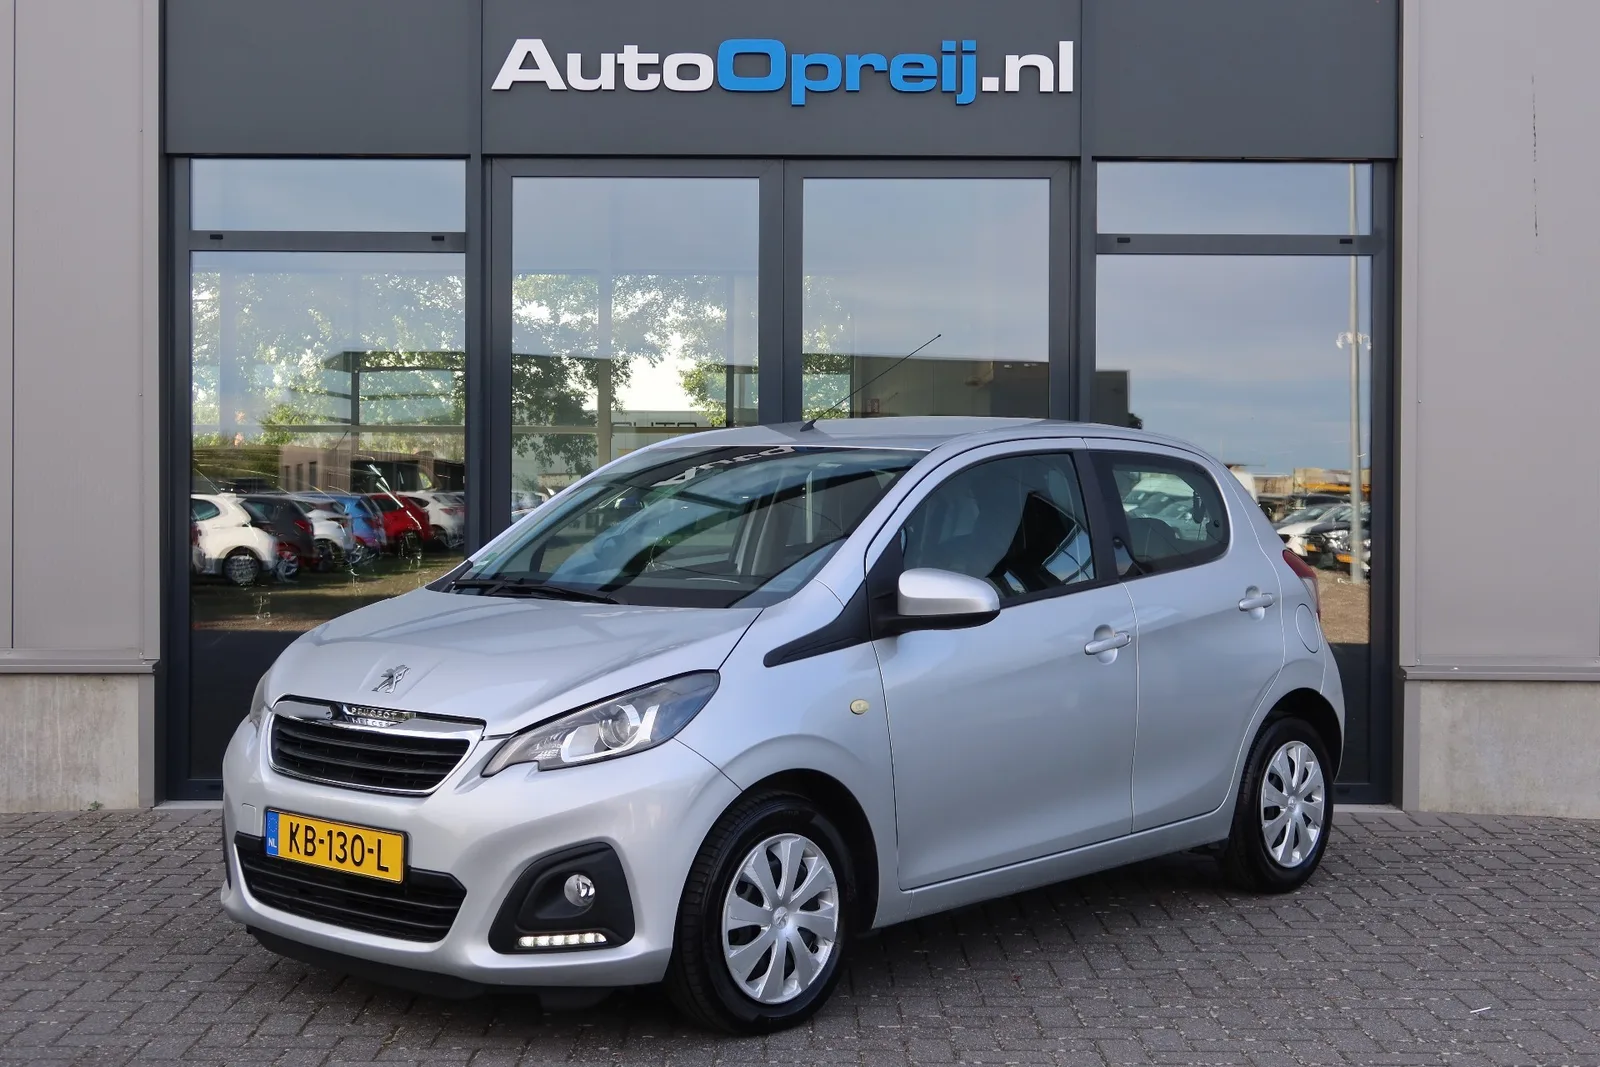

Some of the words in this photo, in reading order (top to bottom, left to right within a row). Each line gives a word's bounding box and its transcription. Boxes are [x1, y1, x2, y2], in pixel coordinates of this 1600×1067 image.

[491, 38, 1074, 105] AutoOpreij.nl
[351, 707, 397, 720] PEUGEOT
[268, 837, 277, 848] NL
[289, 822, 389, 872] KB-130-L
